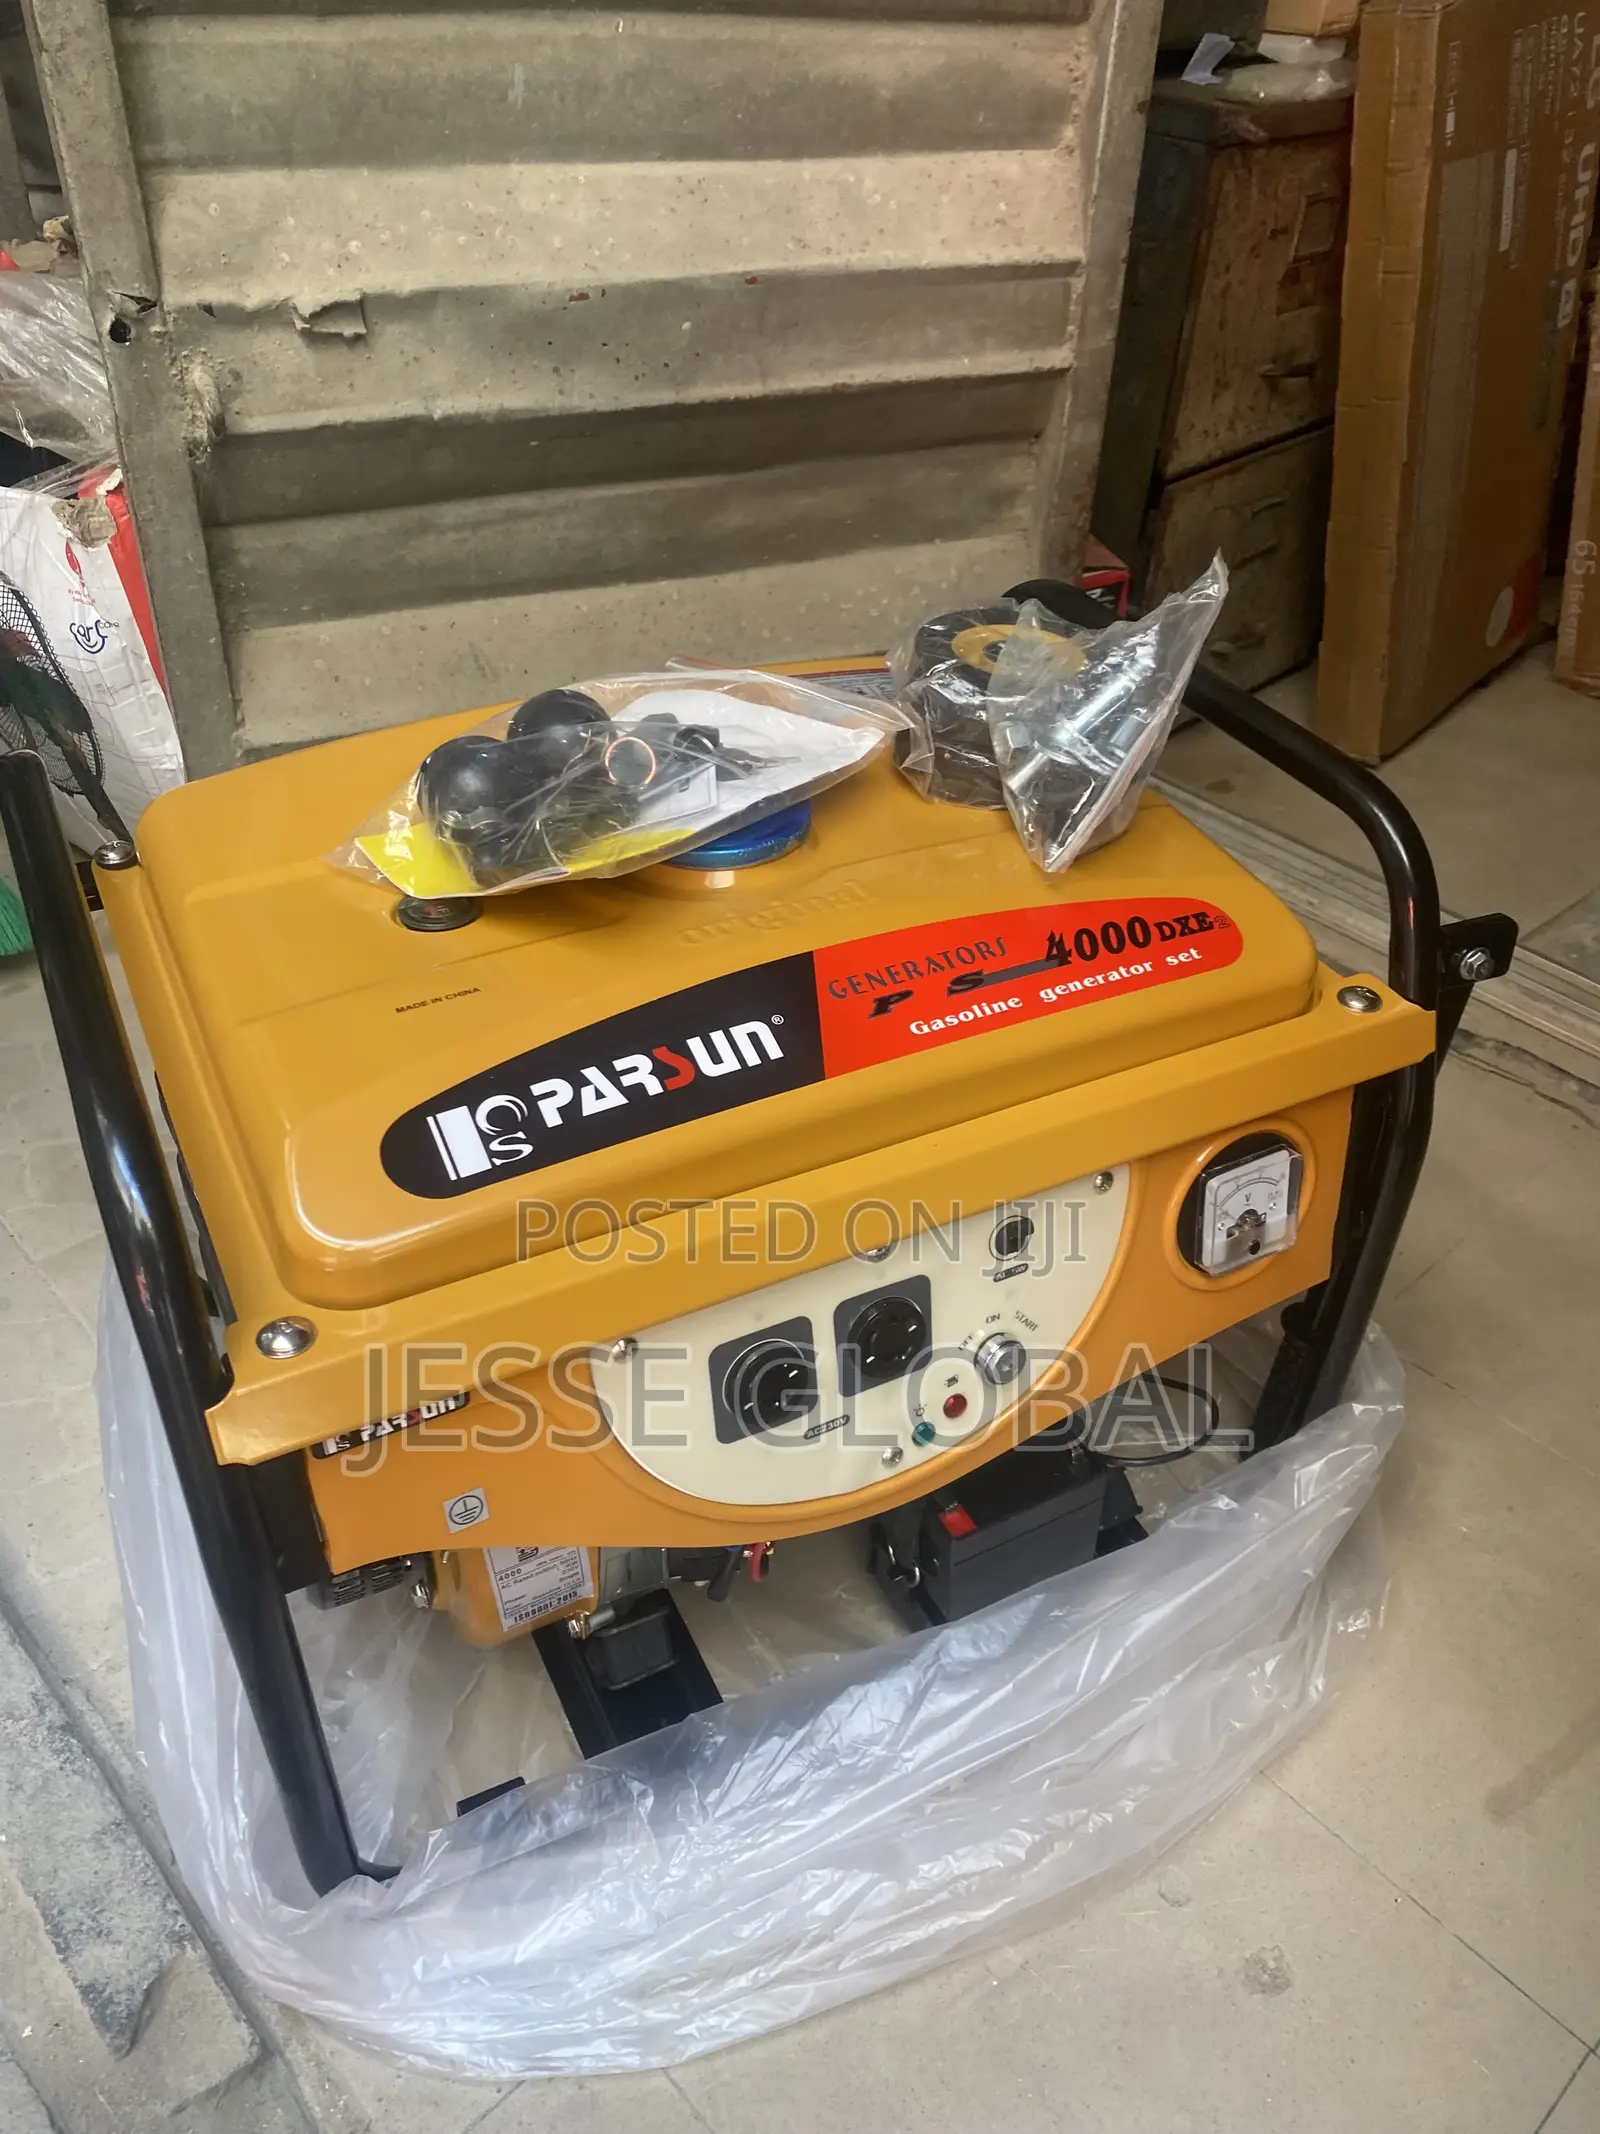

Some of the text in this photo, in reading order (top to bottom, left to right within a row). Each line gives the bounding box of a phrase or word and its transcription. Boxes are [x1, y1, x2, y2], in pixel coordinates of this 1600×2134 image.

[827, 936, 1007, 1000] GENERATORS
[395, 987, 482, 1014] MADE IN CHINA
[909, 946, 1203, 1036] Gasoline generator set
[868, 989, 914, 1020] P
[985, 1312, 1001, 1324] ON
[1014, 1310, 1039, 1332] START
[806, 1415, 848, 1439] AC230V
[498, 1567, 523, 1582] 4000
